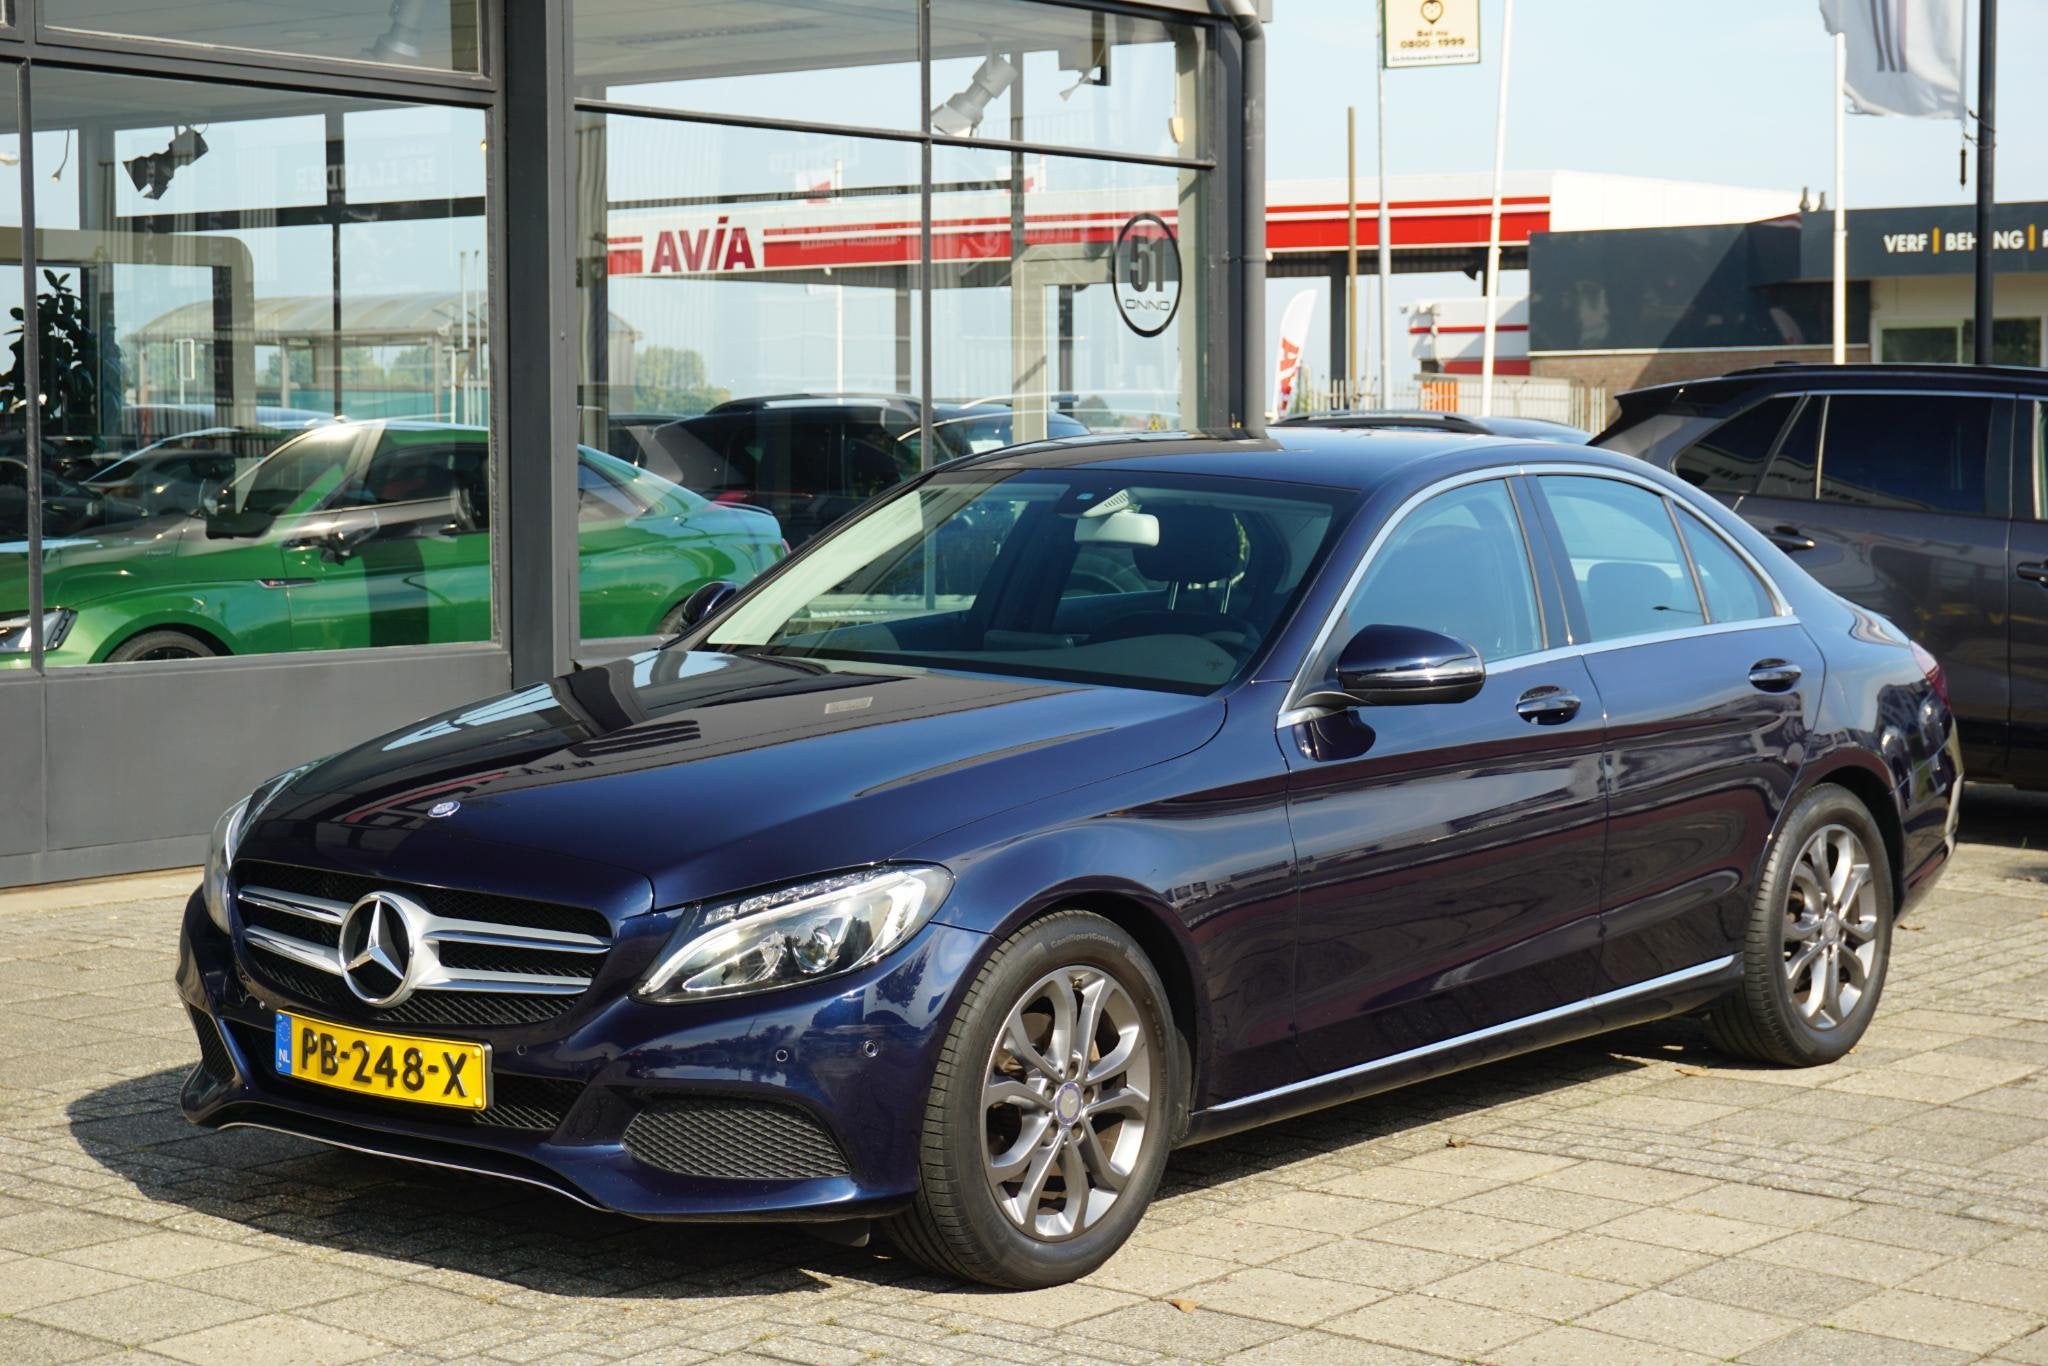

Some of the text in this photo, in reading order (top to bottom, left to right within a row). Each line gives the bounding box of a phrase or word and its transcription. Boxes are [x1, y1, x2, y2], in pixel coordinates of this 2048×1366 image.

[651, 216, 756, 273] AVIA
[1883, 233, 1928, 253] VERF
[1130, 234, 1164, 292] 51
[1124, 298, 1170, 311] ONNO
[278, 1047, 291, 1065] NL
[301, 1027, 468, 1098] PB-248-X
